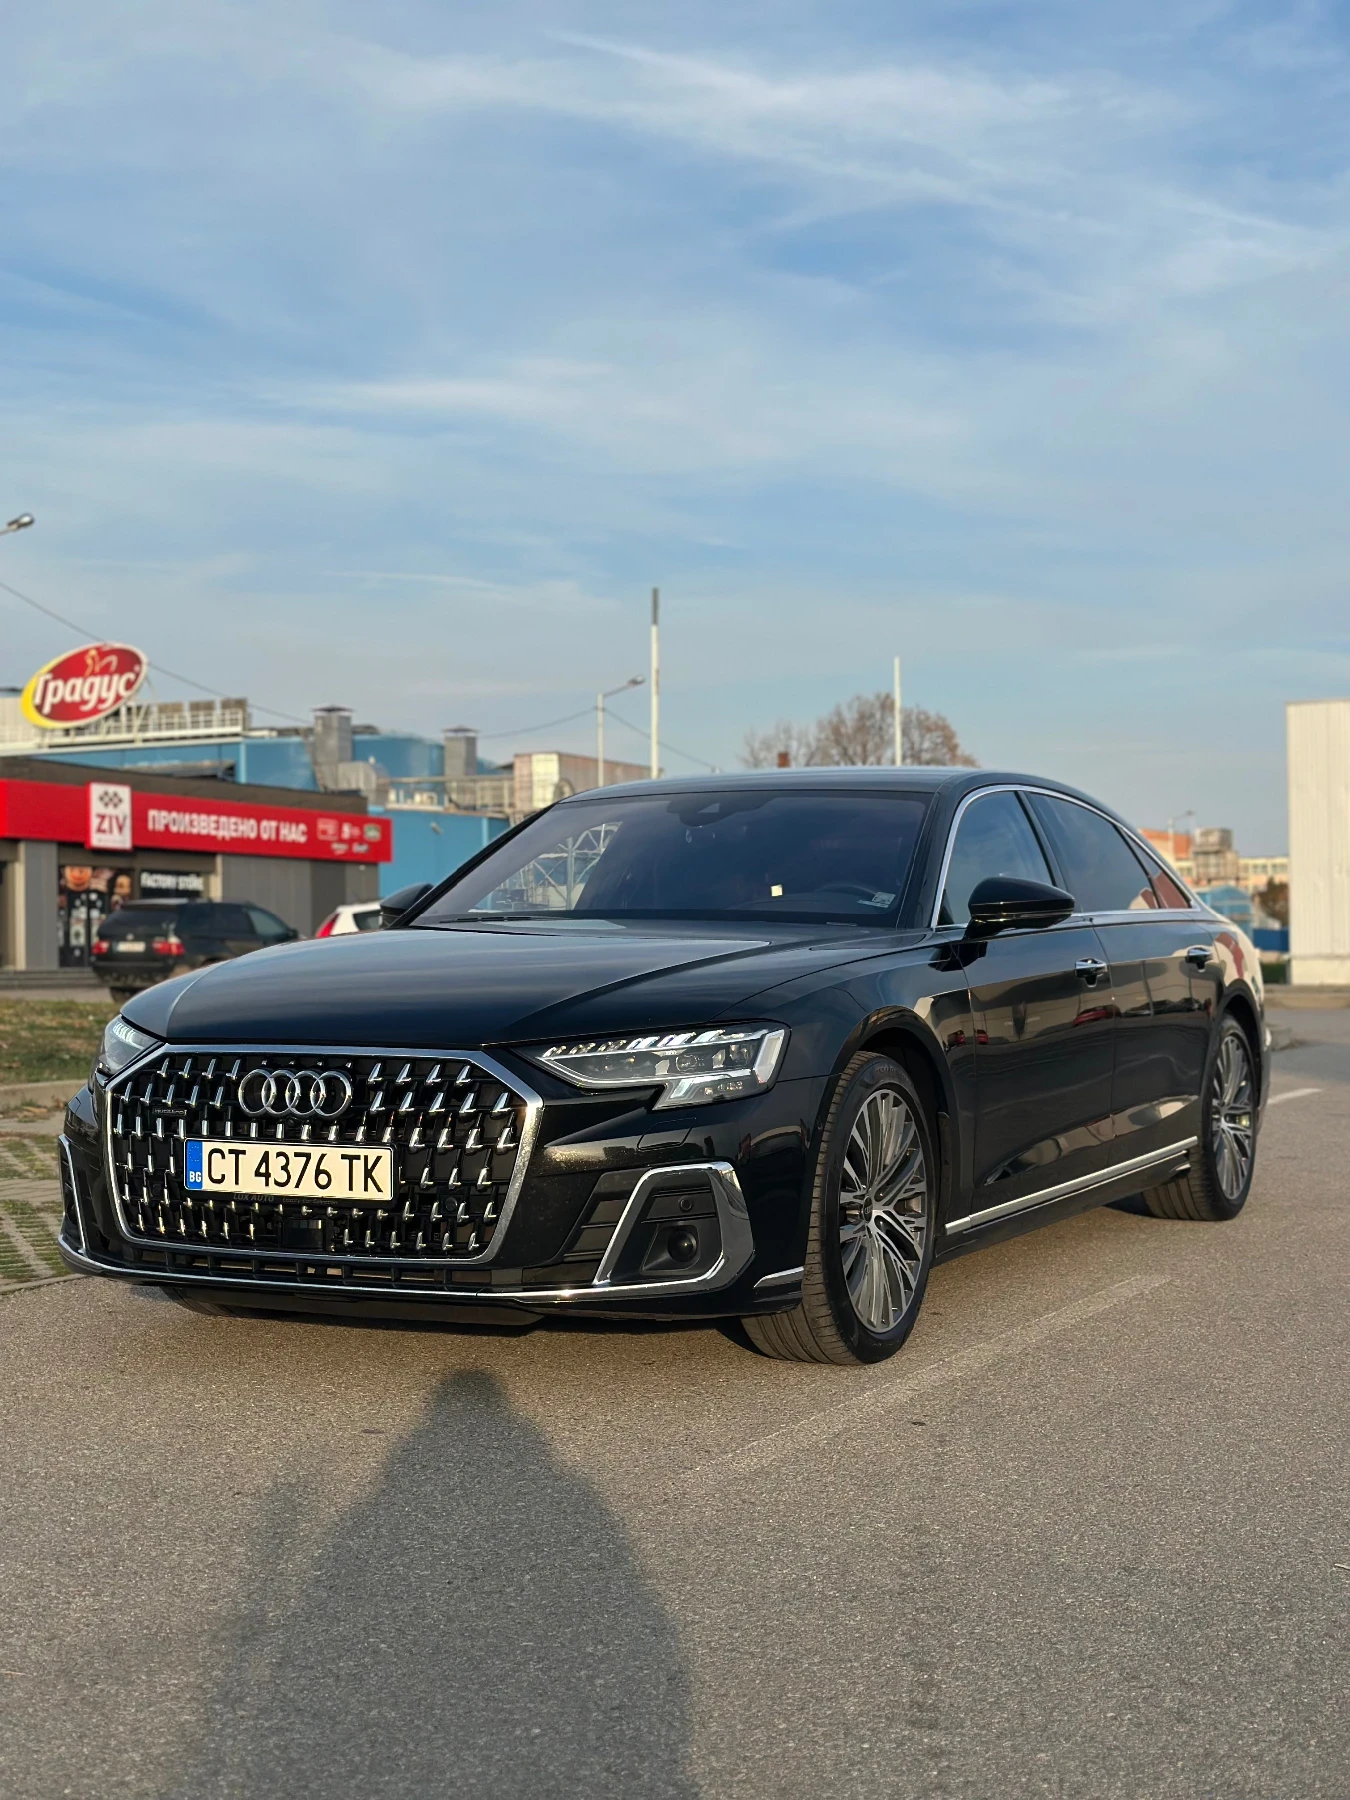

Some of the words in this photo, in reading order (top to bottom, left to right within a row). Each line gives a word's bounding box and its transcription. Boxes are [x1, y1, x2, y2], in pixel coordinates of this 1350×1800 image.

[34, 671, 136, 715] Градус
[96, 813, 127, 835] ZIV
[147, 809, 257, 840] ПРОИЗВЕДЕНО
[259, 820, 278, 839] ОТ
[280, 821, 308, 843] НАС
[189, 1171, 202, 1183] BG
[207, 1147, 246, 1186] CT
[254, 1150, 332, 1190] 4376
[340, 1153, 384, 1193] TK
[233, 1193, 249, 1201] LUX
[250, 1194, 275, 1202] AUTO
